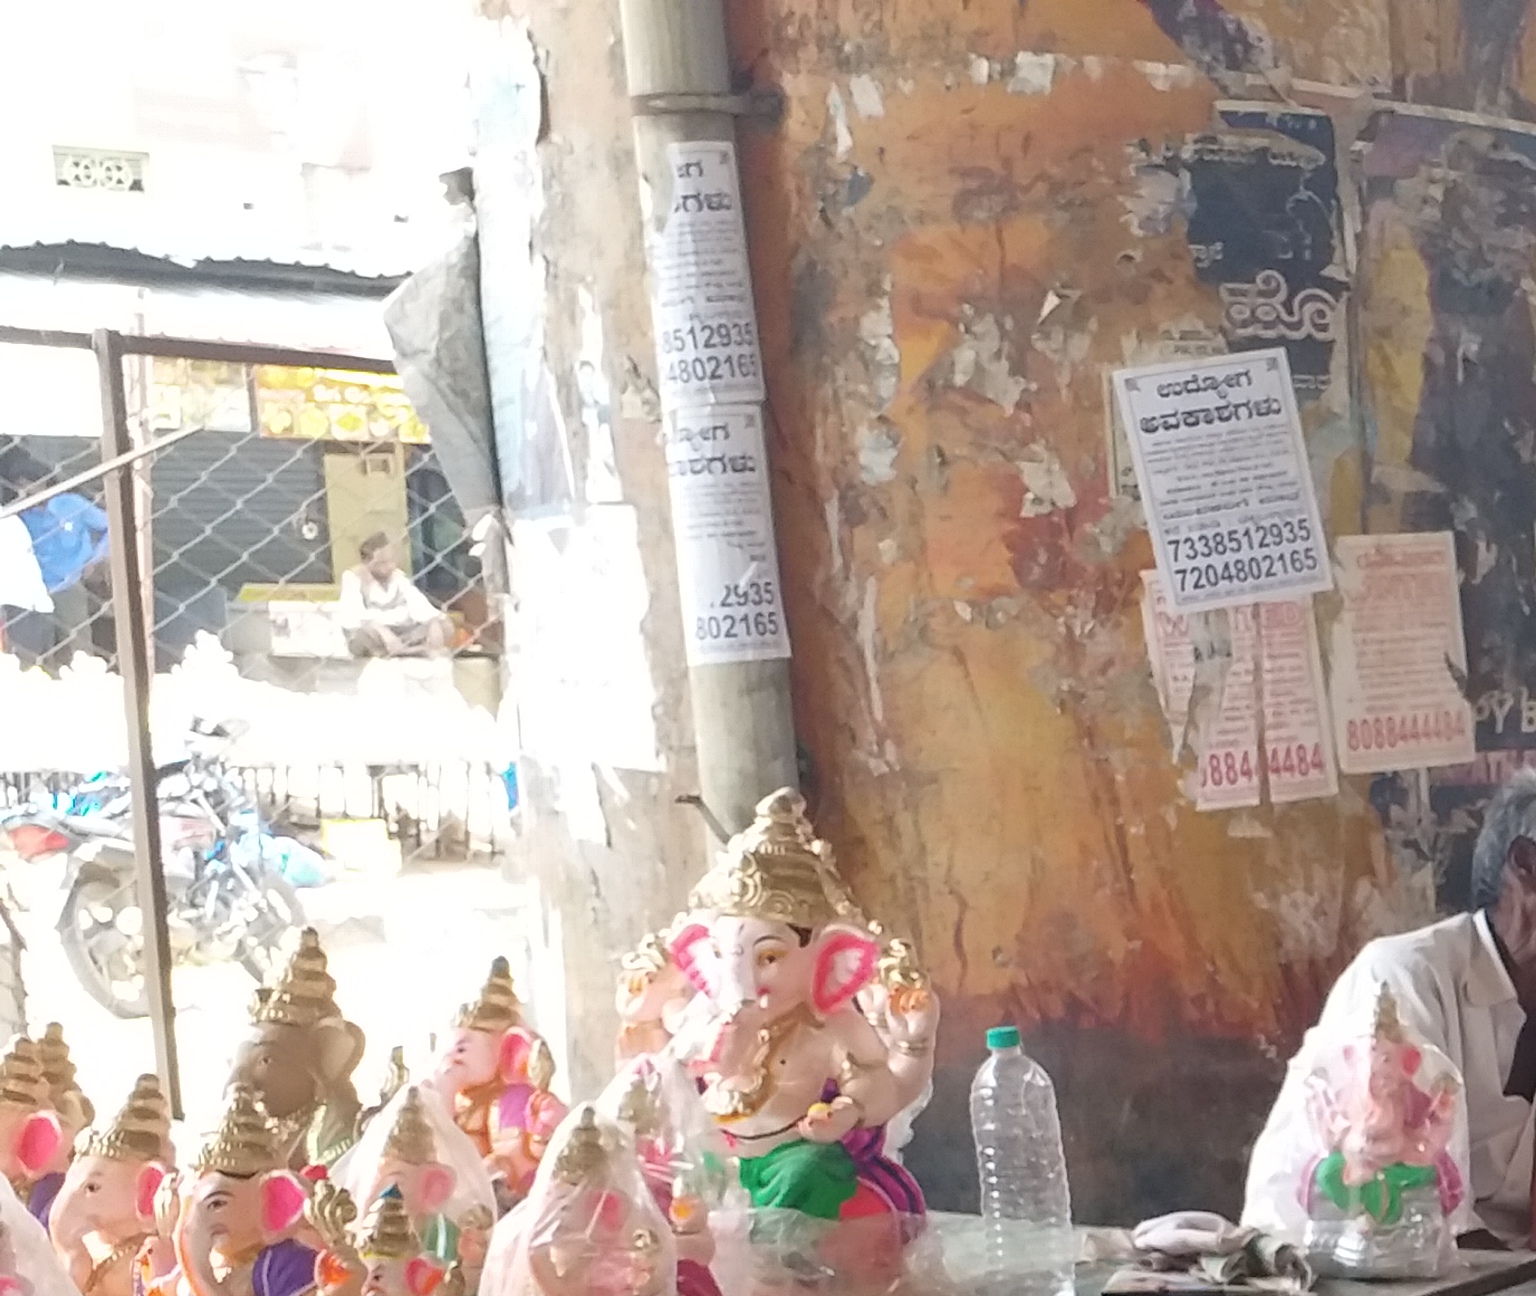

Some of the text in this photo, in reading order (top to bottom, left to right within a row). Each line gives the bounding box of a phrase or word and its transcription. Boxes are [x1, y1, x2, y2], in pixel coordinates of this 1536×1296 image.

[1157, 369, 1252, 400] ಉದ್ಯೋಗ
[1140, 396, 1282, 434] ಅವಕಾಶಗಳು
[1167, 518, 1311, 563] 7338512935
[1174, 547, 1318, 592] 7204802165
[709, 580, 775, 608] 2935
